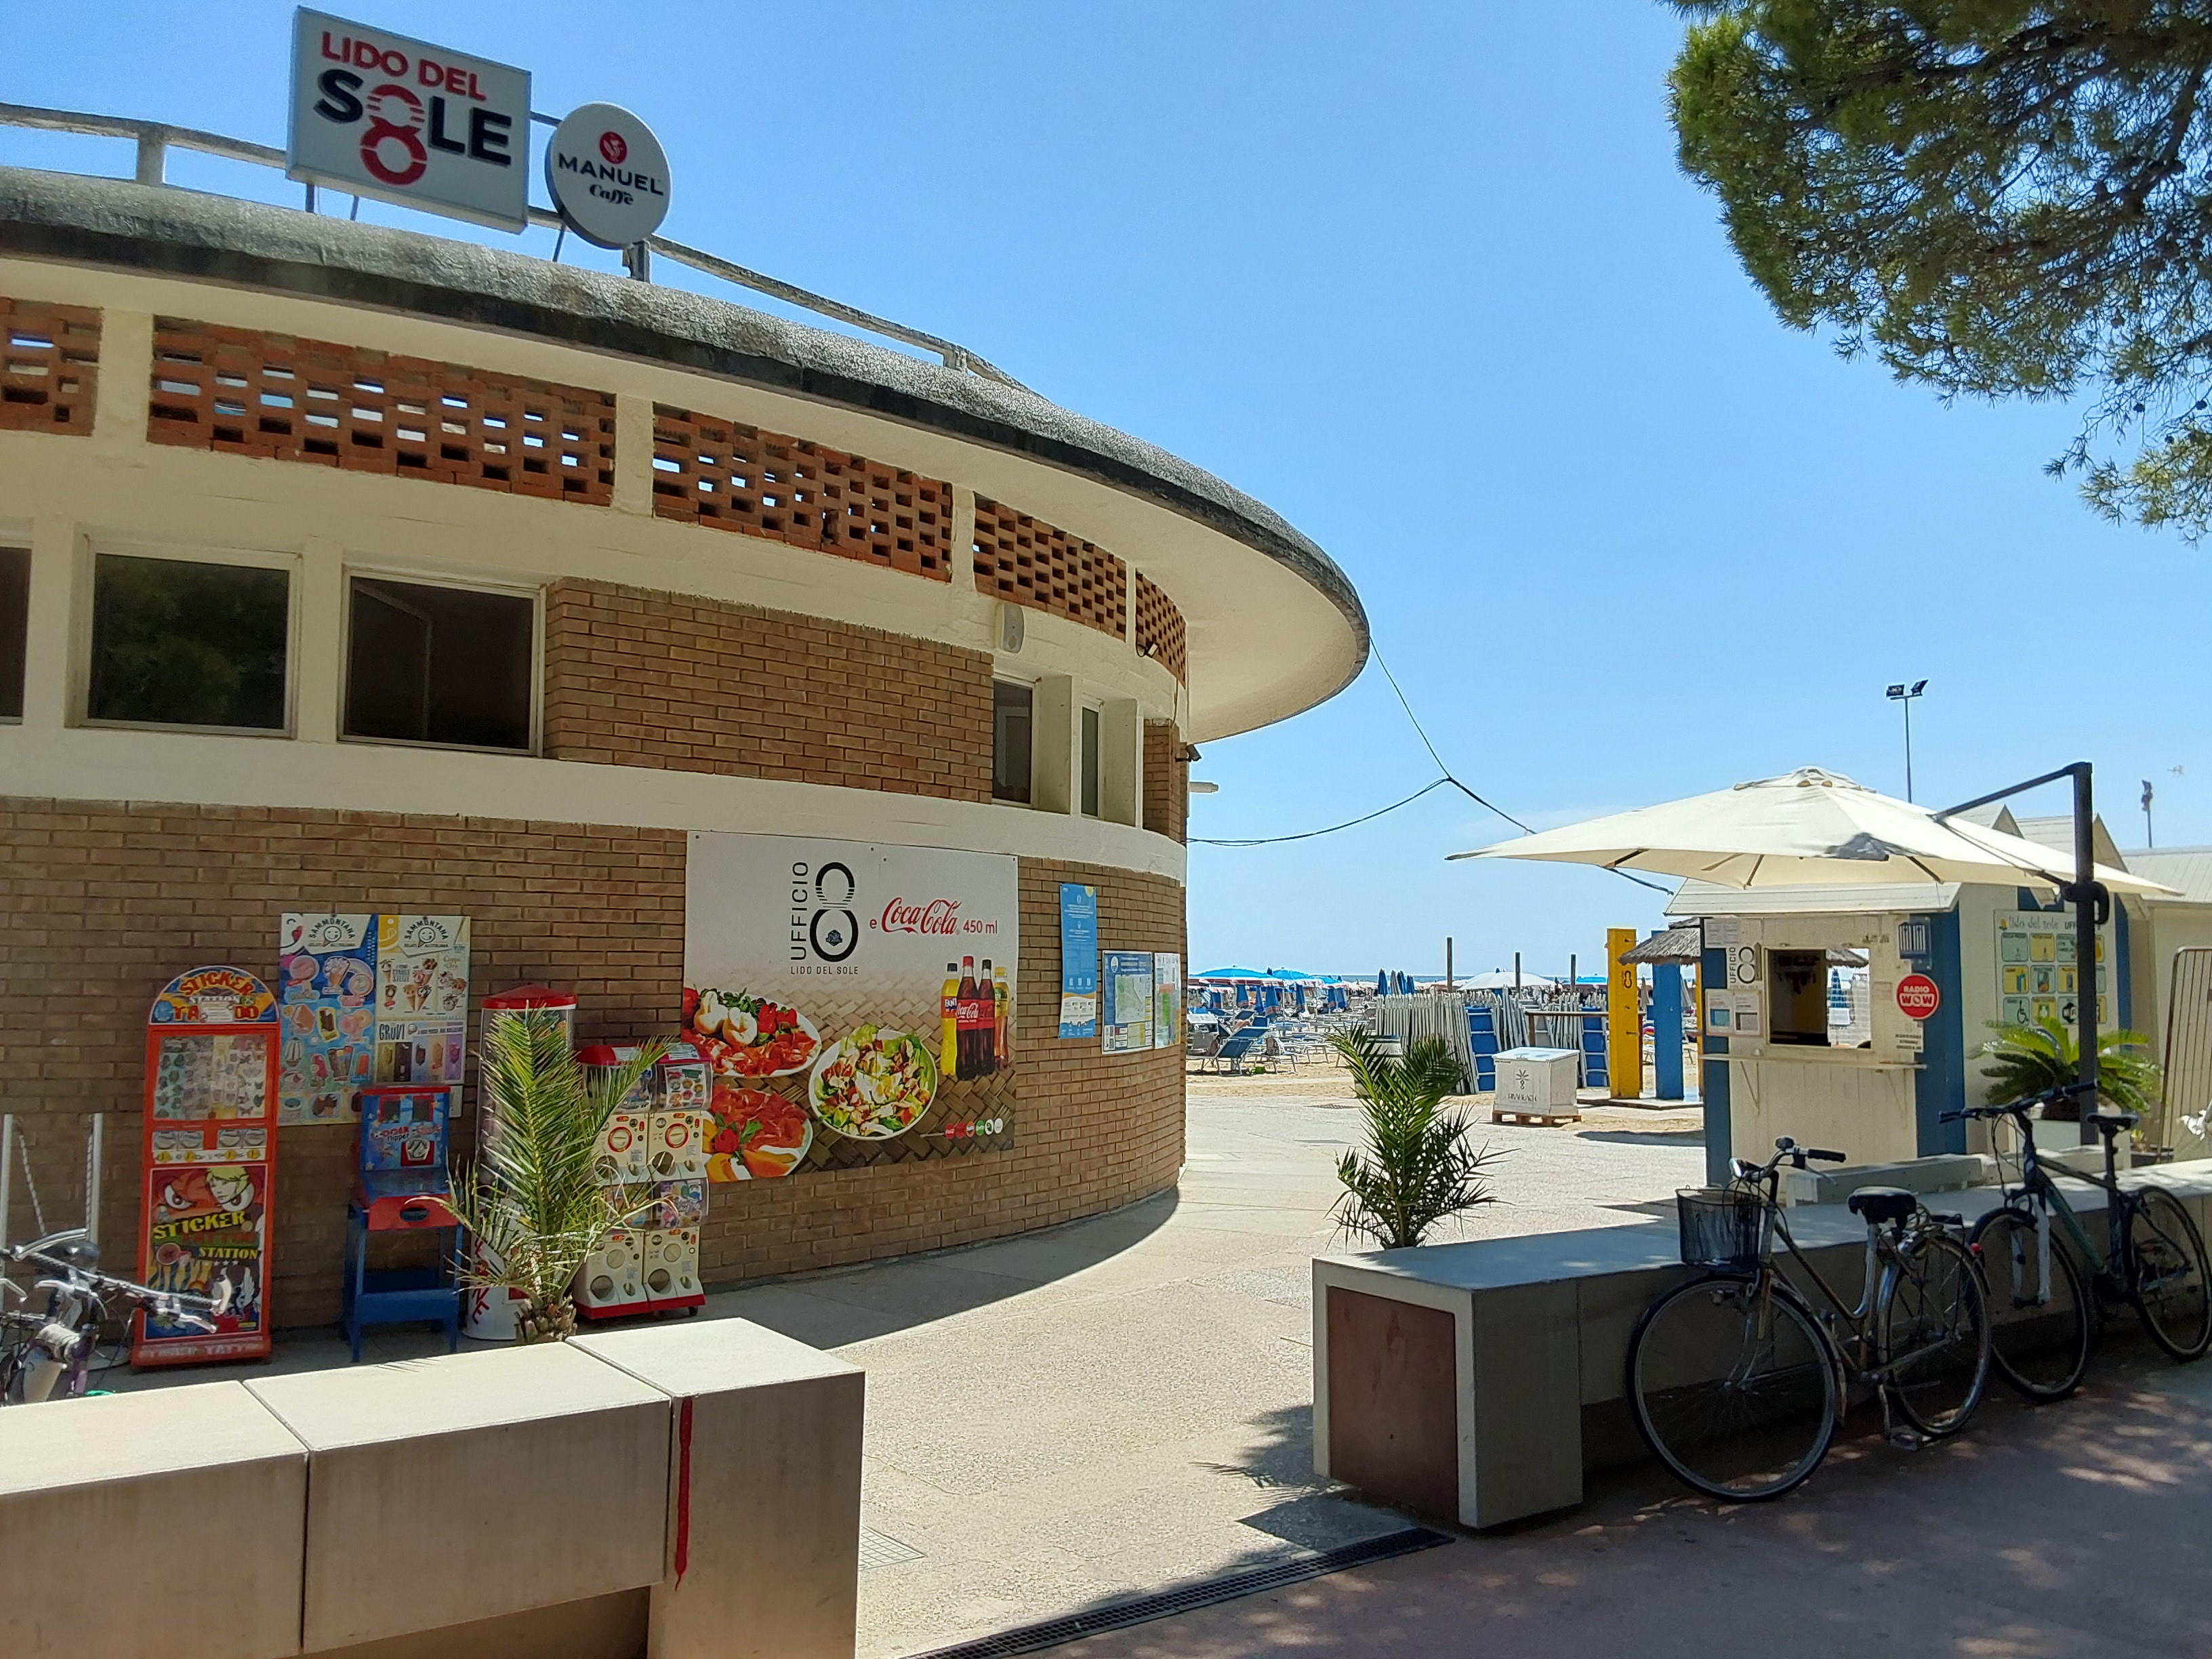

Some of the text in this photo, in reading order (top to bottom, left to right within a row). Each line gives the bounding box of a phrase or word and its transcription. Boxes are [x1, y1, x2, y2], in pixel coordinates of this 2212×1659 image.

[321, 31, 487, 101] LIDO DEL
[558, 152, 663, 197] MANUEL
[590, 184, 634, 205] Caffè
[790, 862, 808, 960] UFFICIO
[869, 897, 998, 935] e Coca-Cola 450 ml
[308, 918, 356, 939] SAMMONTANA
[404, 918, 449, 940] SAMMONTANA
[791, 966, 859, 975] LIDO DEL SOLE
[179, 971, 255, 996] STICKER
[188, 995, 241, 1004] STATION
[1900, 994, 1934, 1008] WOW
[173, 1005, 260, 1021] TAOO
[152, 1210, 245, 1240] STICKER
[199, 1247, 258, 1260] STATION
